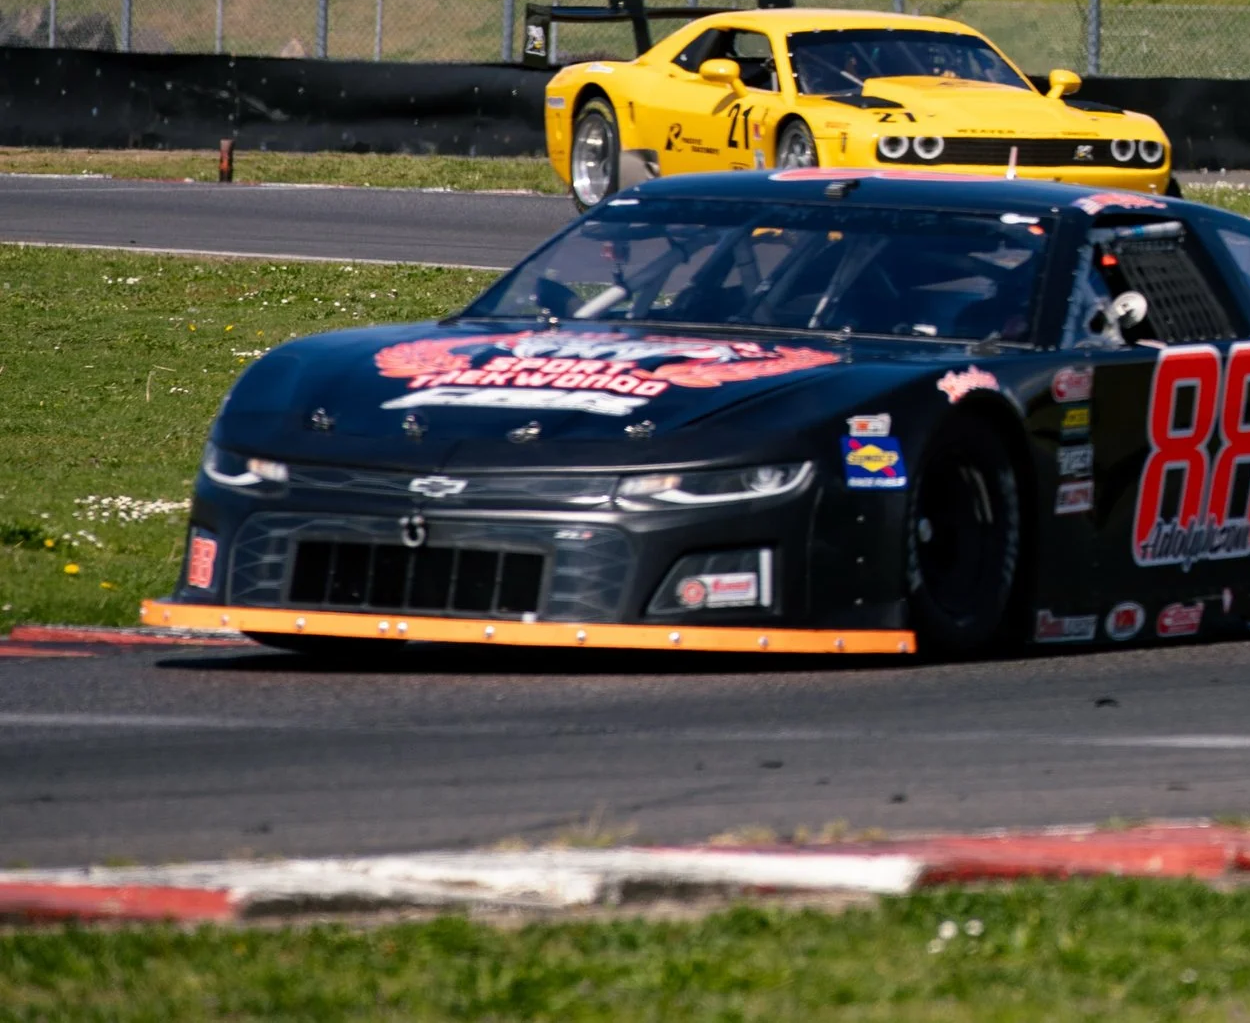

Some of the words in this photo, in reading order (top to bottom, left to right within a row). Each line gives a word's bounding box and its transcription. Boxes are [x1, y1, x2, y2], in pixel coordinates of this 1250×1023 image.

[727, 103, 755, 150] 21
[872, 112, 918, 123] 21
[483, 356, 637, 375] SPORT
[407, 370, 671, 397] TAEKWONDO
